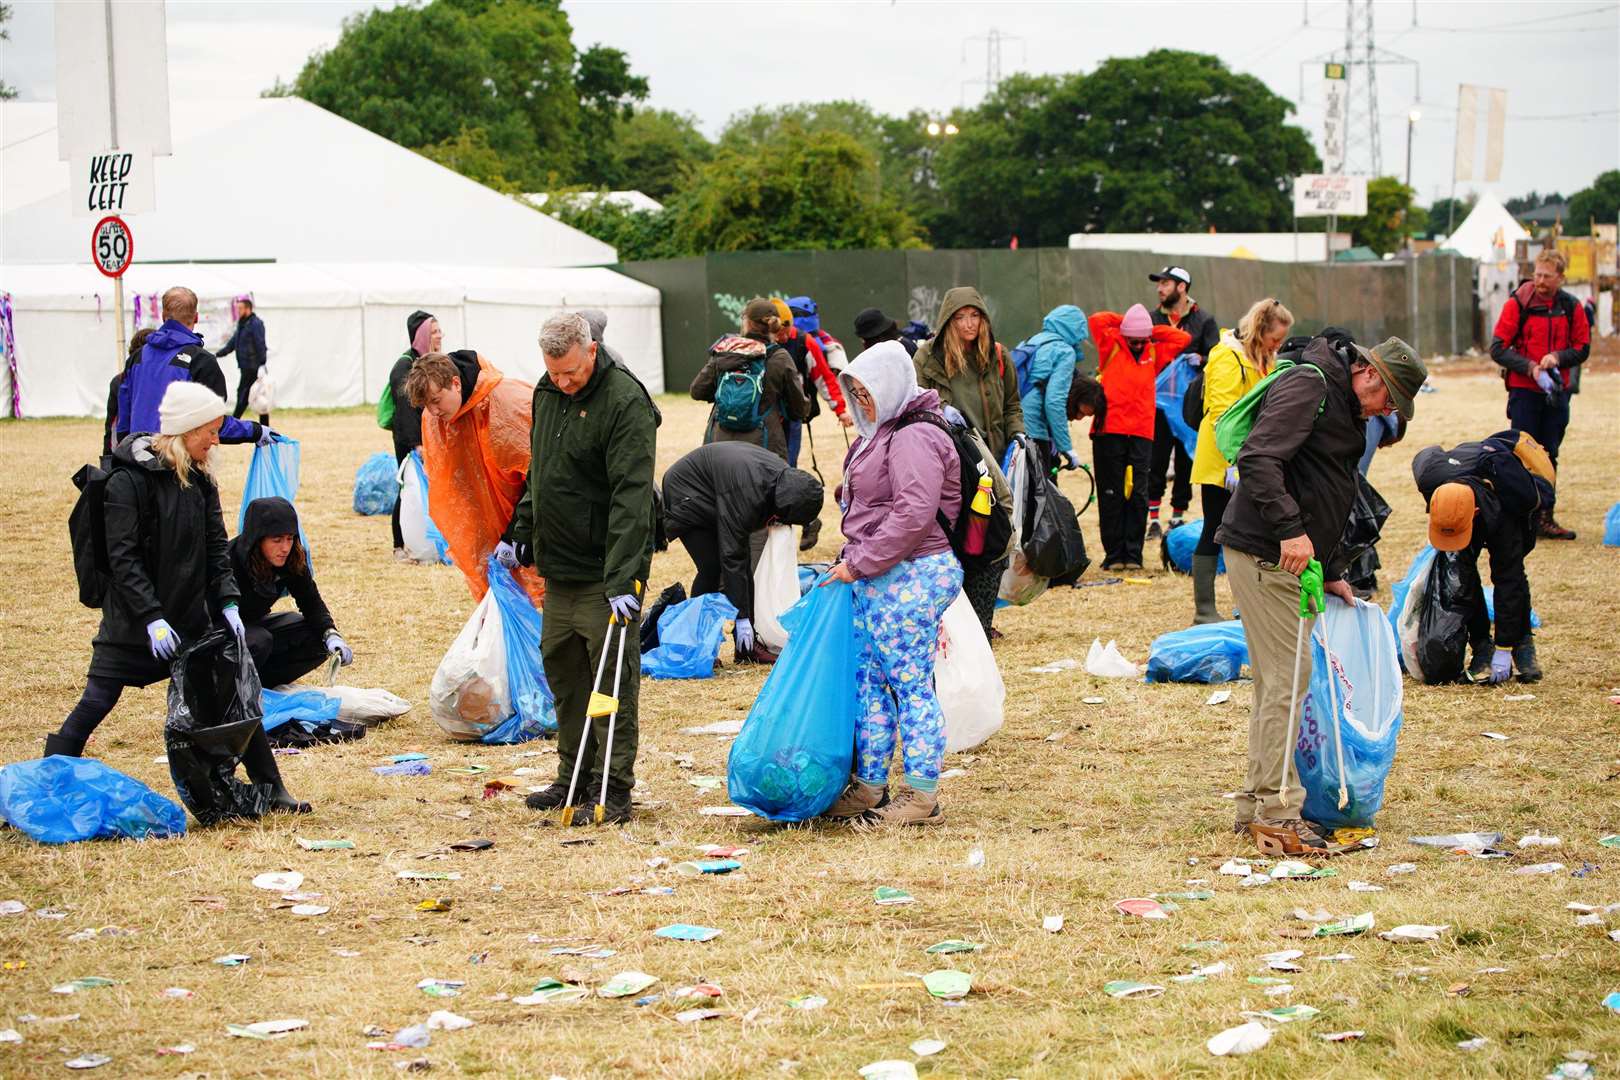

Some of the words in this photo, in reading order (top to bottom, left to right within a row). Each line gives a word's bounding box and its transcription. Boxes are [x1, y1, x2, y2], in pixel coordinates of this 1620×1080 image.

[90, 153, 133, 184] KEEP
[88, 182, 129, 211] LEFT
[98, 234, 127, 259] 50
